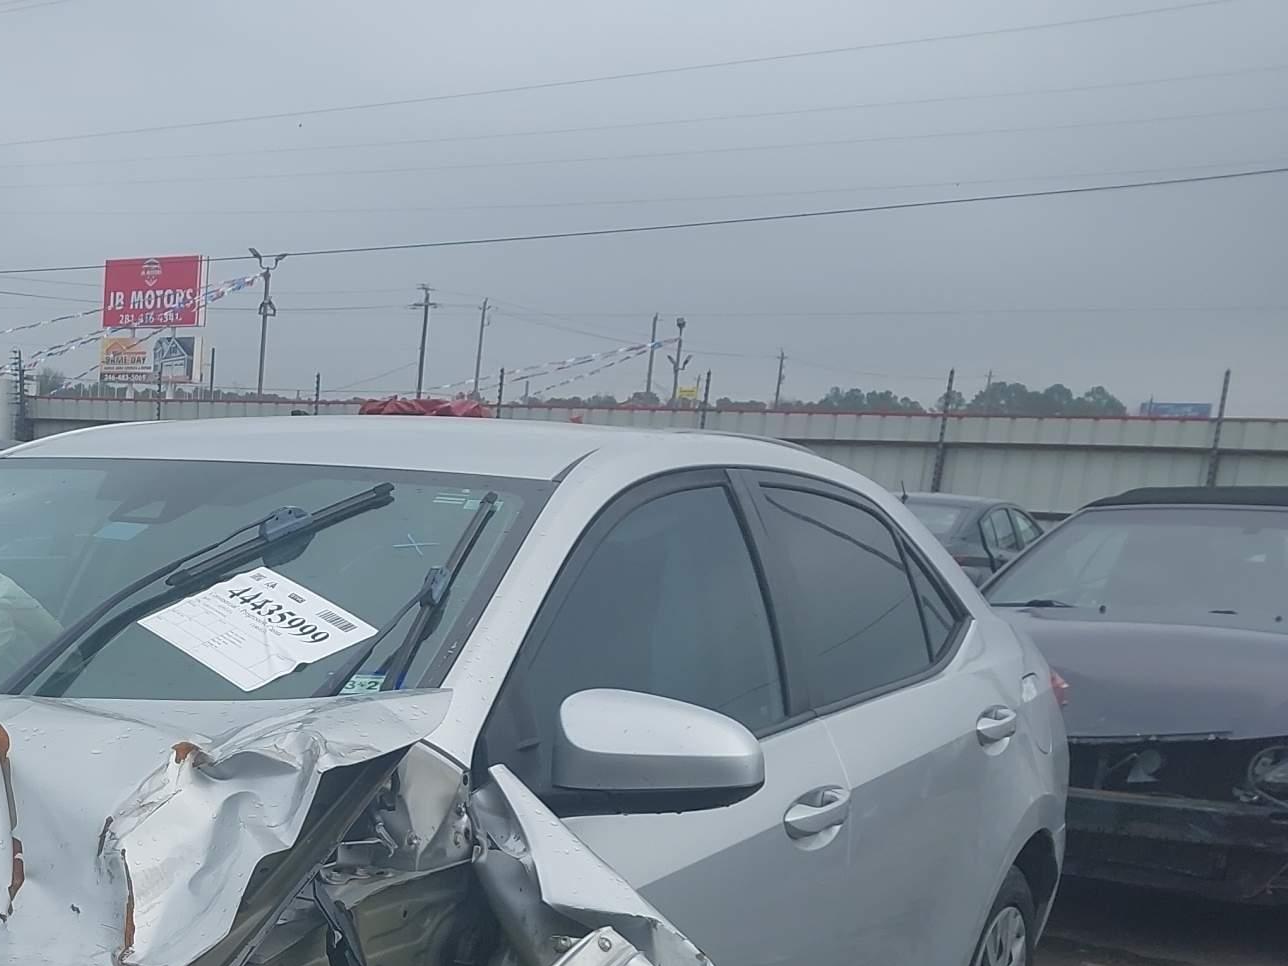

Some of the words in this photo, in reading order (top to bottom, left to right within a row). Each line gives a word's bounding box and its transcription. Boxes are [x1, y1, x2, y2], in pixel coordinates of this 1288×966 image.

[107, 291, 124, 310] JB
[130, 288, 193, 310] MOTORS
[228, 587, 330, 643] 44435999
